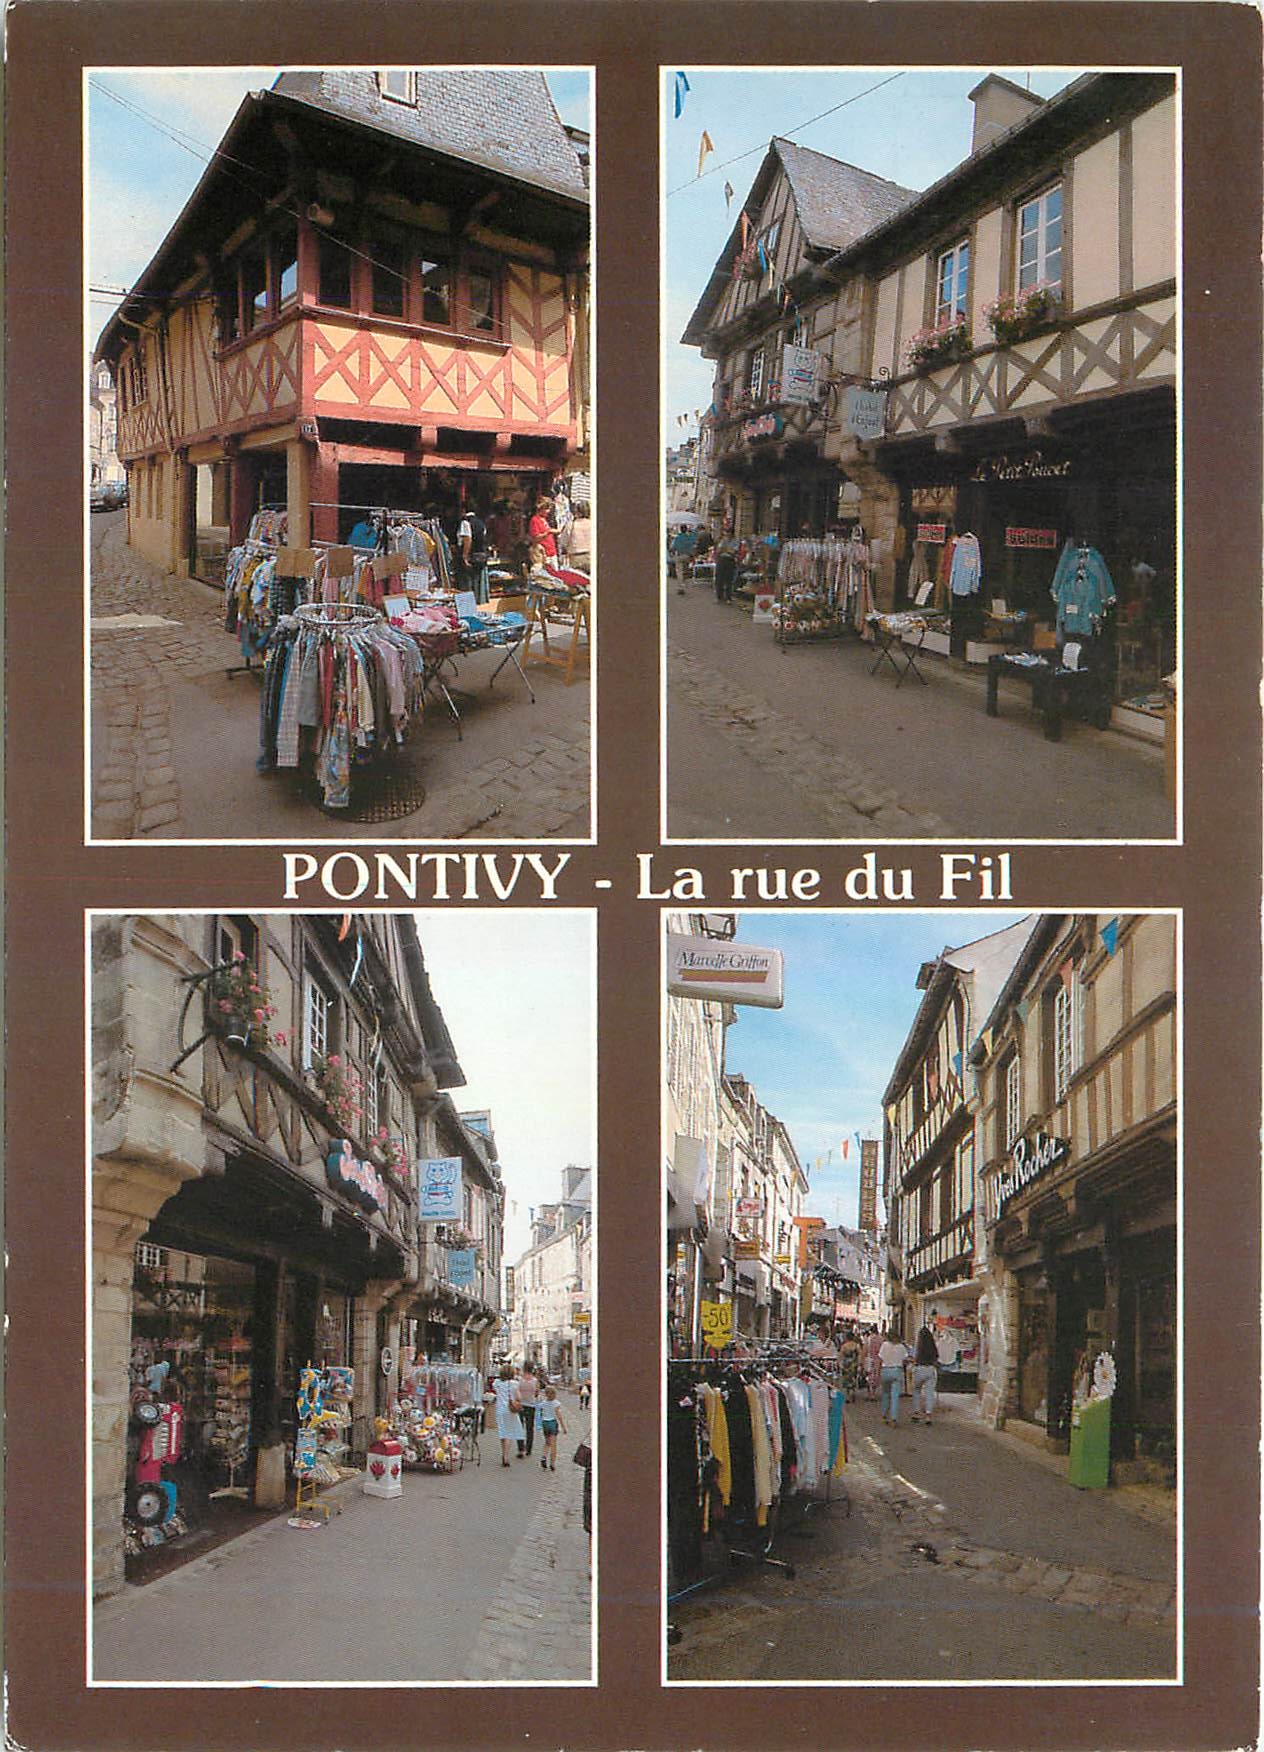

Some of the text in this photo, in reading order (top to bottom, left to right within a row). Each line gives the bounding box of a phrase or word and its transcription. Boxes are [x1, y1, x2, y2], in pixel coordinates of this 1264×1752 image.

[728, 953, 769, 970] Griffon
[992, 1132, 1065, 1221] Yves Rocher
